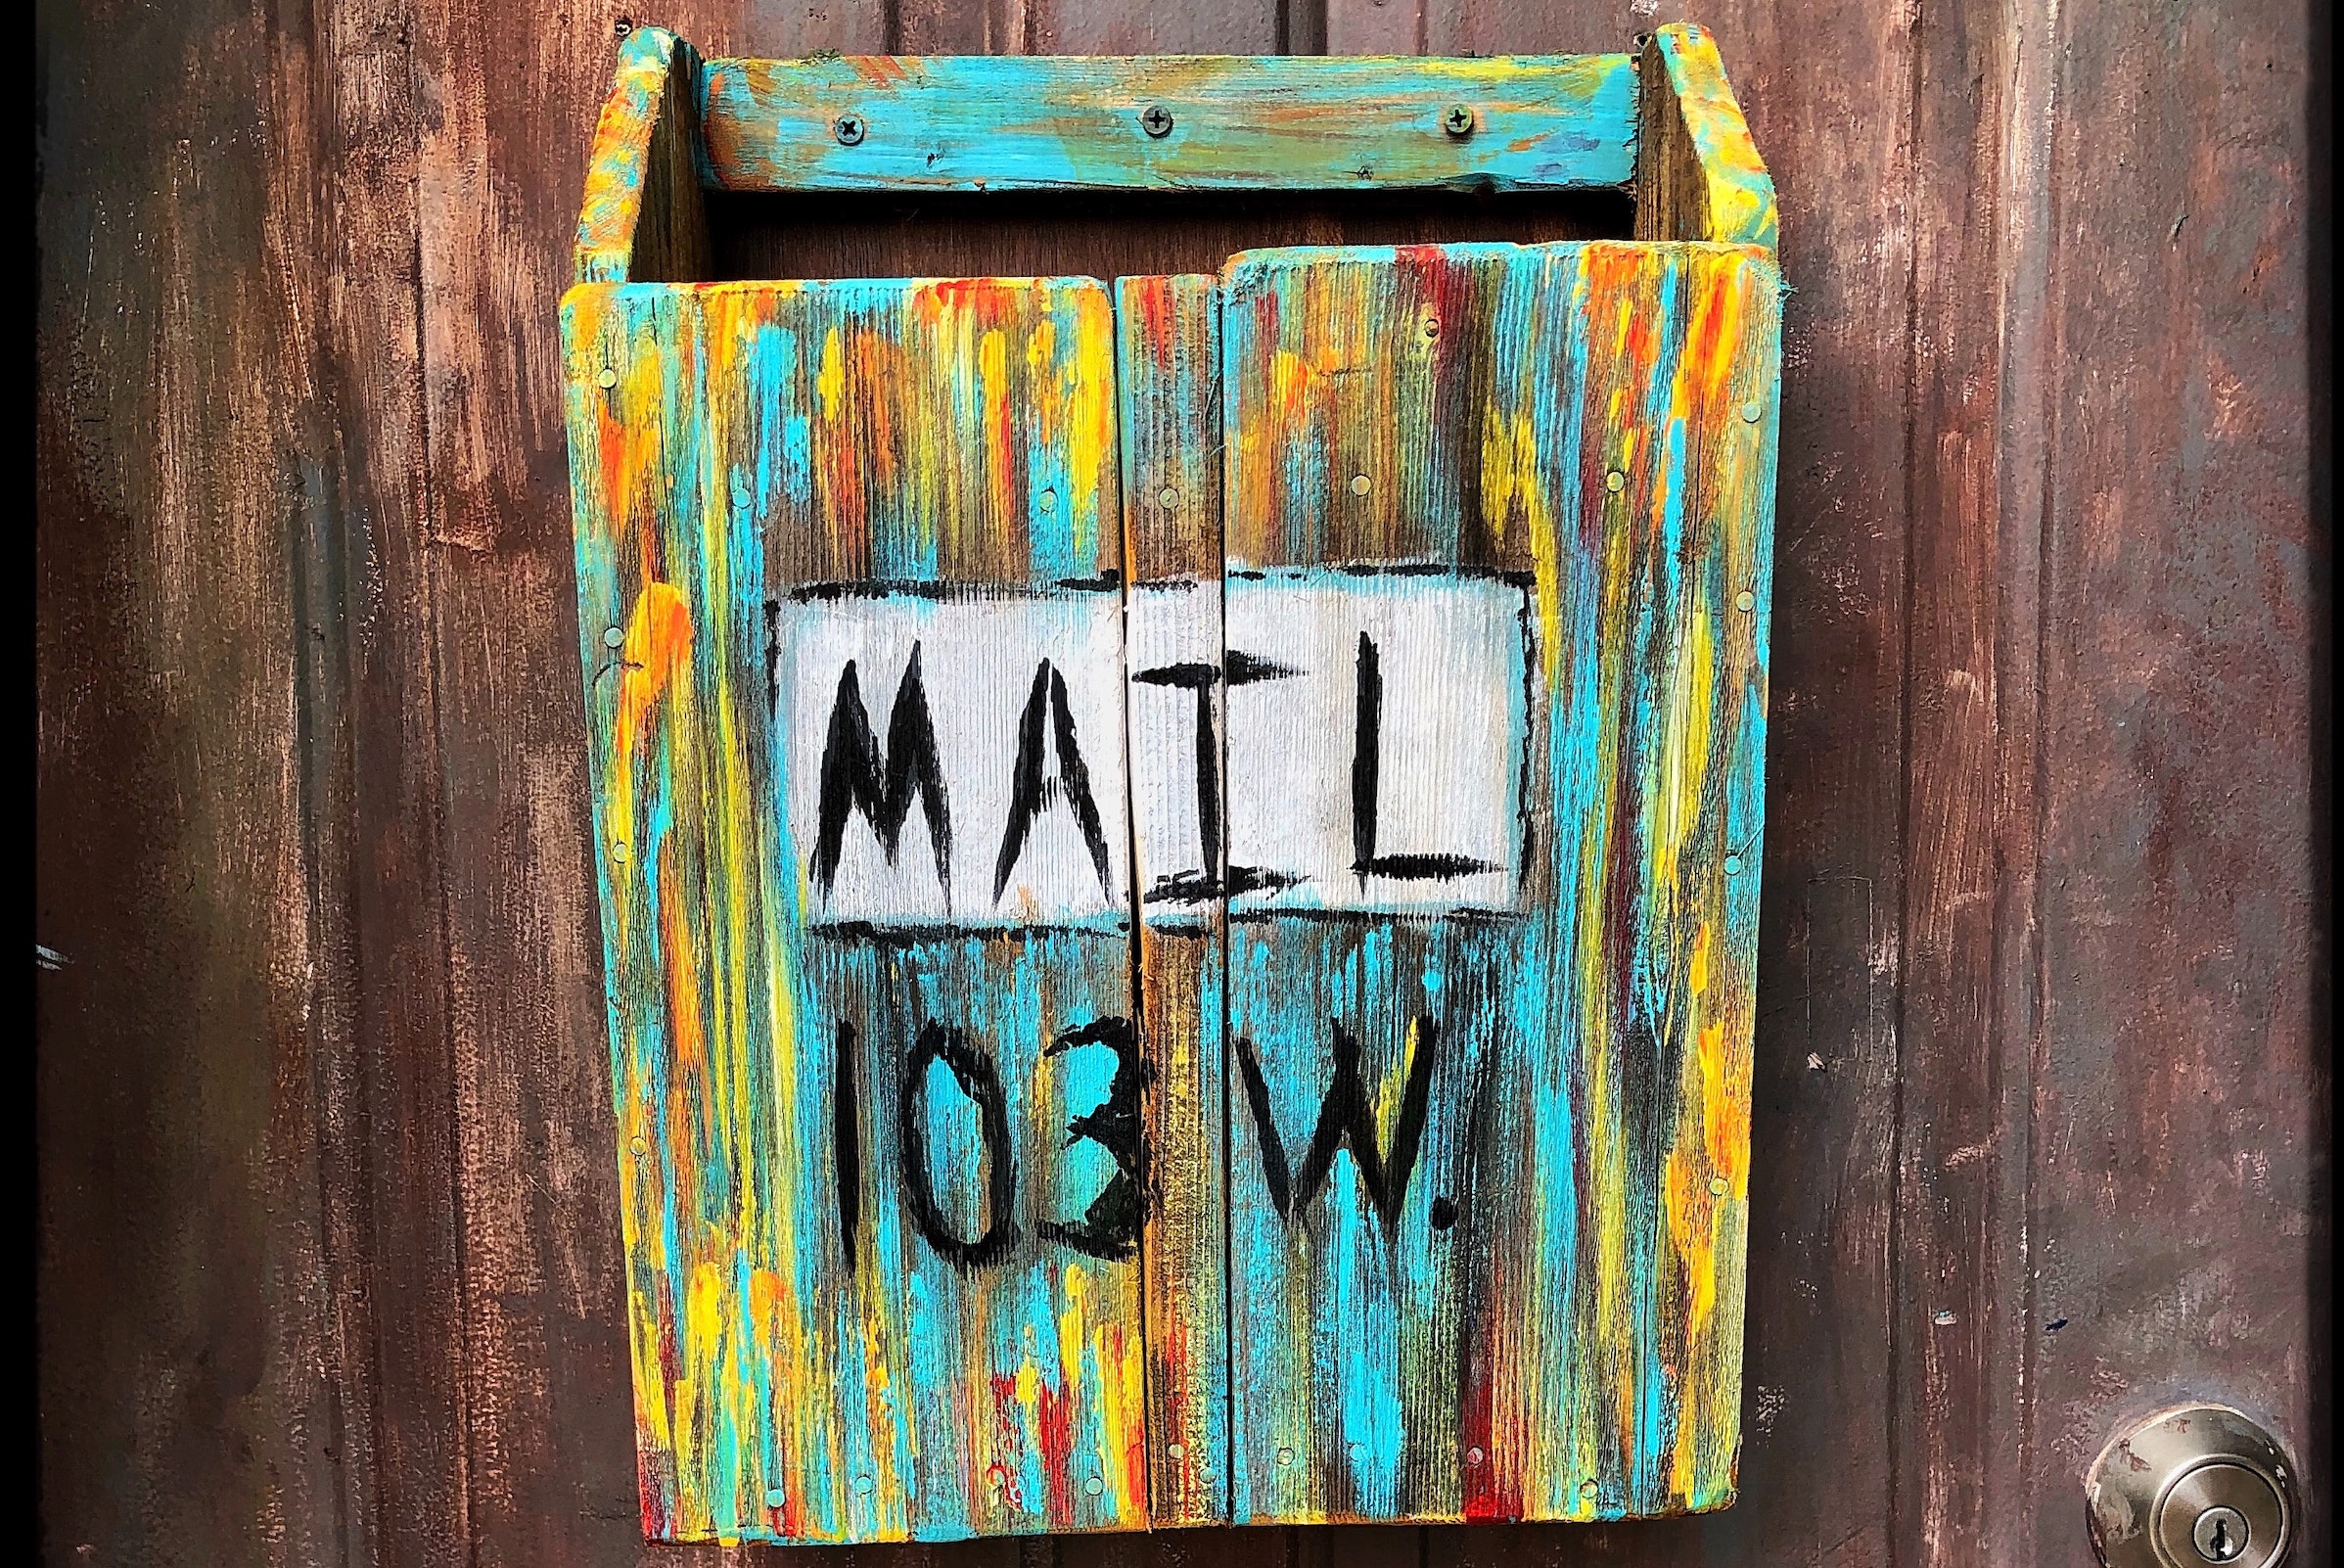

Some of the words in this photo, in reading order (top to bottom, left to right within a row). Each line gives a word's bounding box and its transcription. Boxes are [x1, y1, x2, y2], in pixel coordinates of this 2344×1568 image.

[808, 629, 1507, 914] MAIL
[835, 1015, 1157, 1271] 103
[1234, 1015, 1459, 1239] W.
